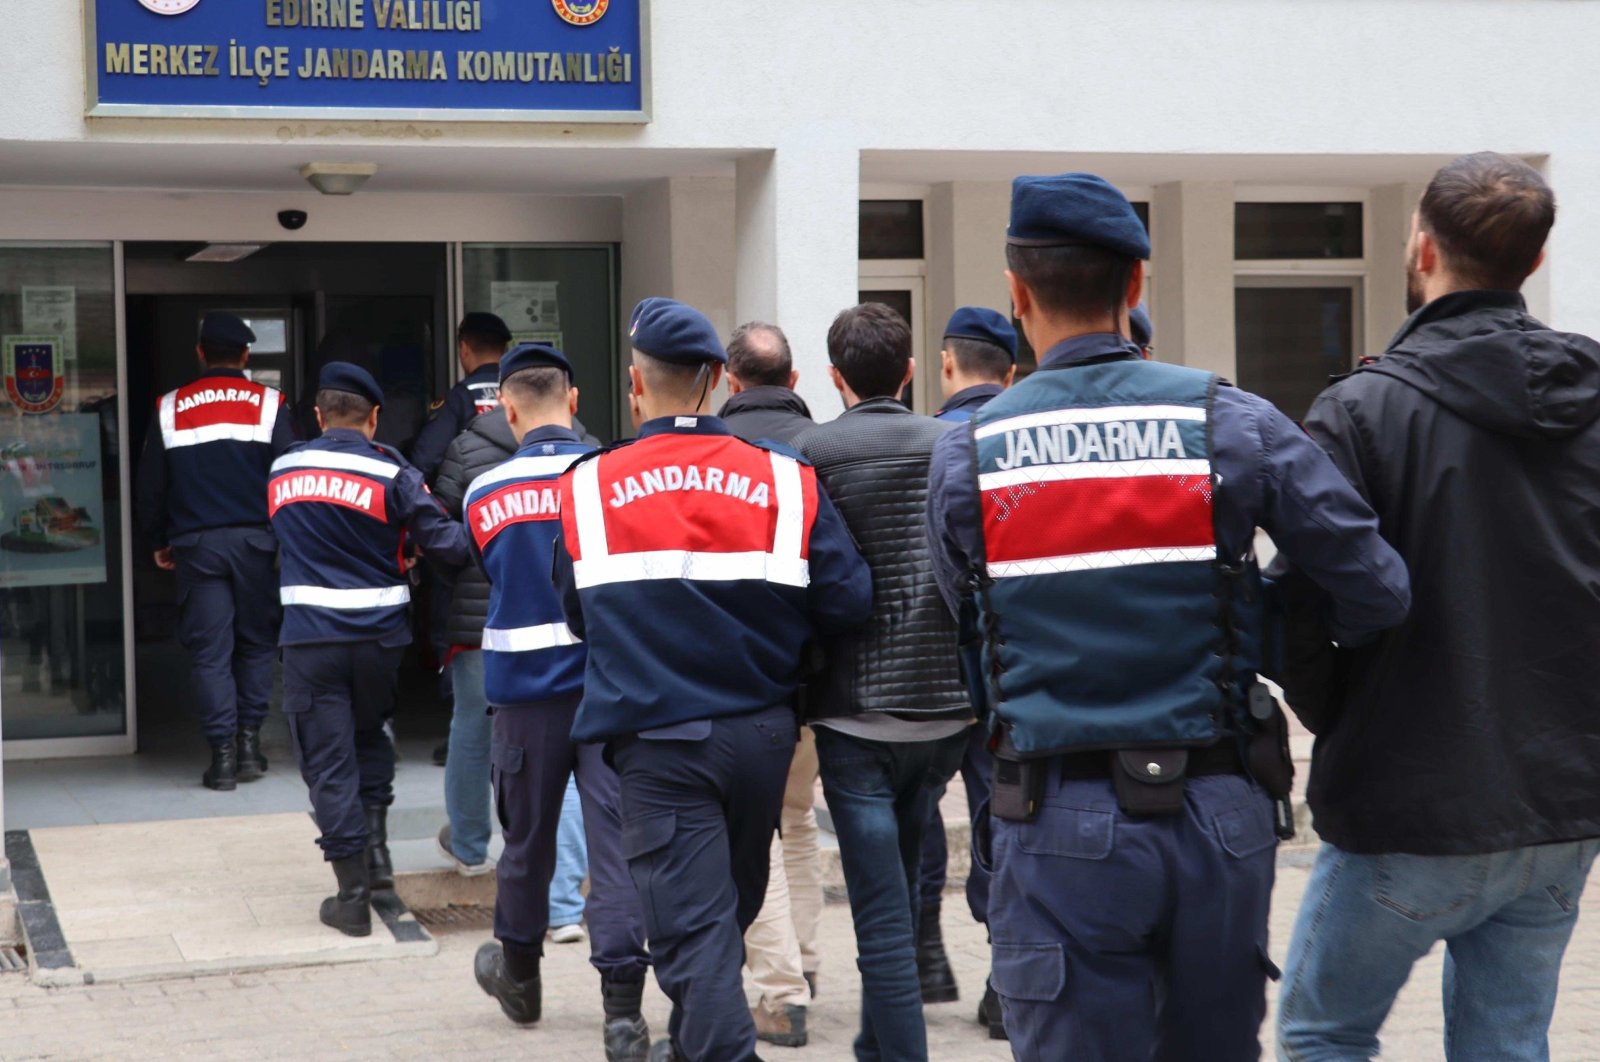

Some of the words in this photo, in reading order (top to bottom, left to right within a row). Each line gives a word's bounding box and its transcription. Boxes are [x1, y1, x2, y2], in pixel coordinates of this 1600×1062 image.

[105, 42, 220, 76] MERKEZ
[229, 38, 290, 86] İLÇE
[297, 48, 448, 80] JANDARMA
[457, 46, 632, 83] KOMUTANLIĞI
[176, 388, 261, 413] JANDARMA
[995, 420, 1187, 470] JANDARMA
[274, 474, 373, 510] JANDARMA
[608, 464, 770, 508] JANDARMA
